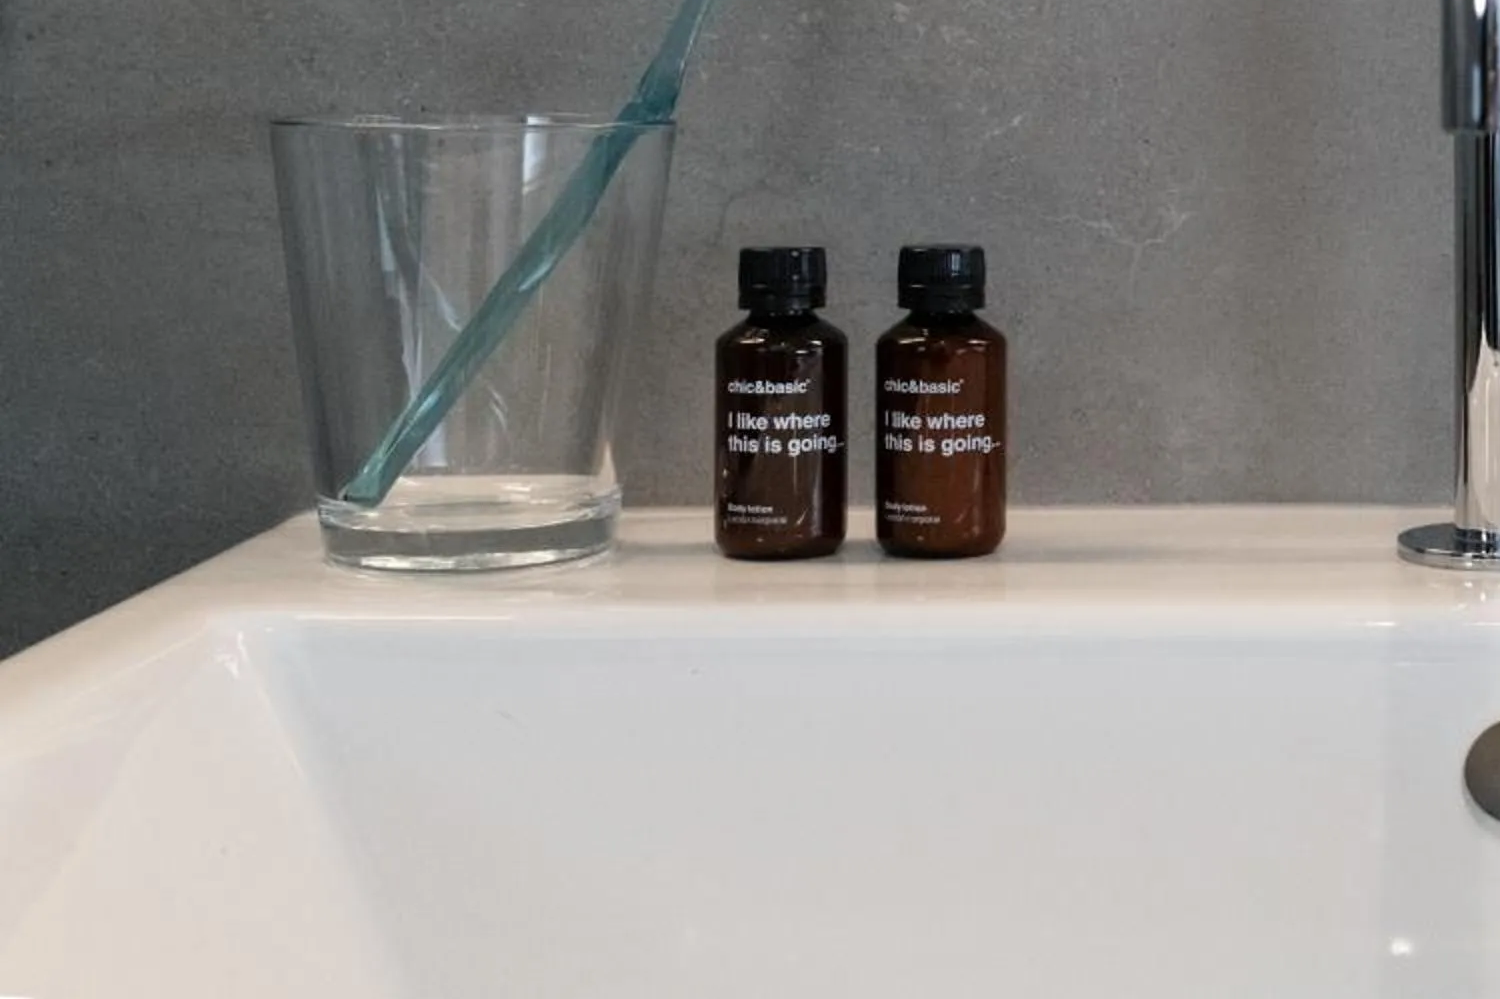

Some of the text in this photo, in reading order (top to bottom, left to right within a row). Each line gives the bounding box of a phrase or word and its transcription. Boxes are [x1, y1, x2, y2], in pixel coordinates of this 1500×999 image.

[727, 411, 832, 431] I like where
[884, 410, 987, 430] I like where
[727, 433, 759, 453] this
[764, 435, 783, 454] is
[884, 432, 914, 452] this
[918, 434, 936, 454] is
